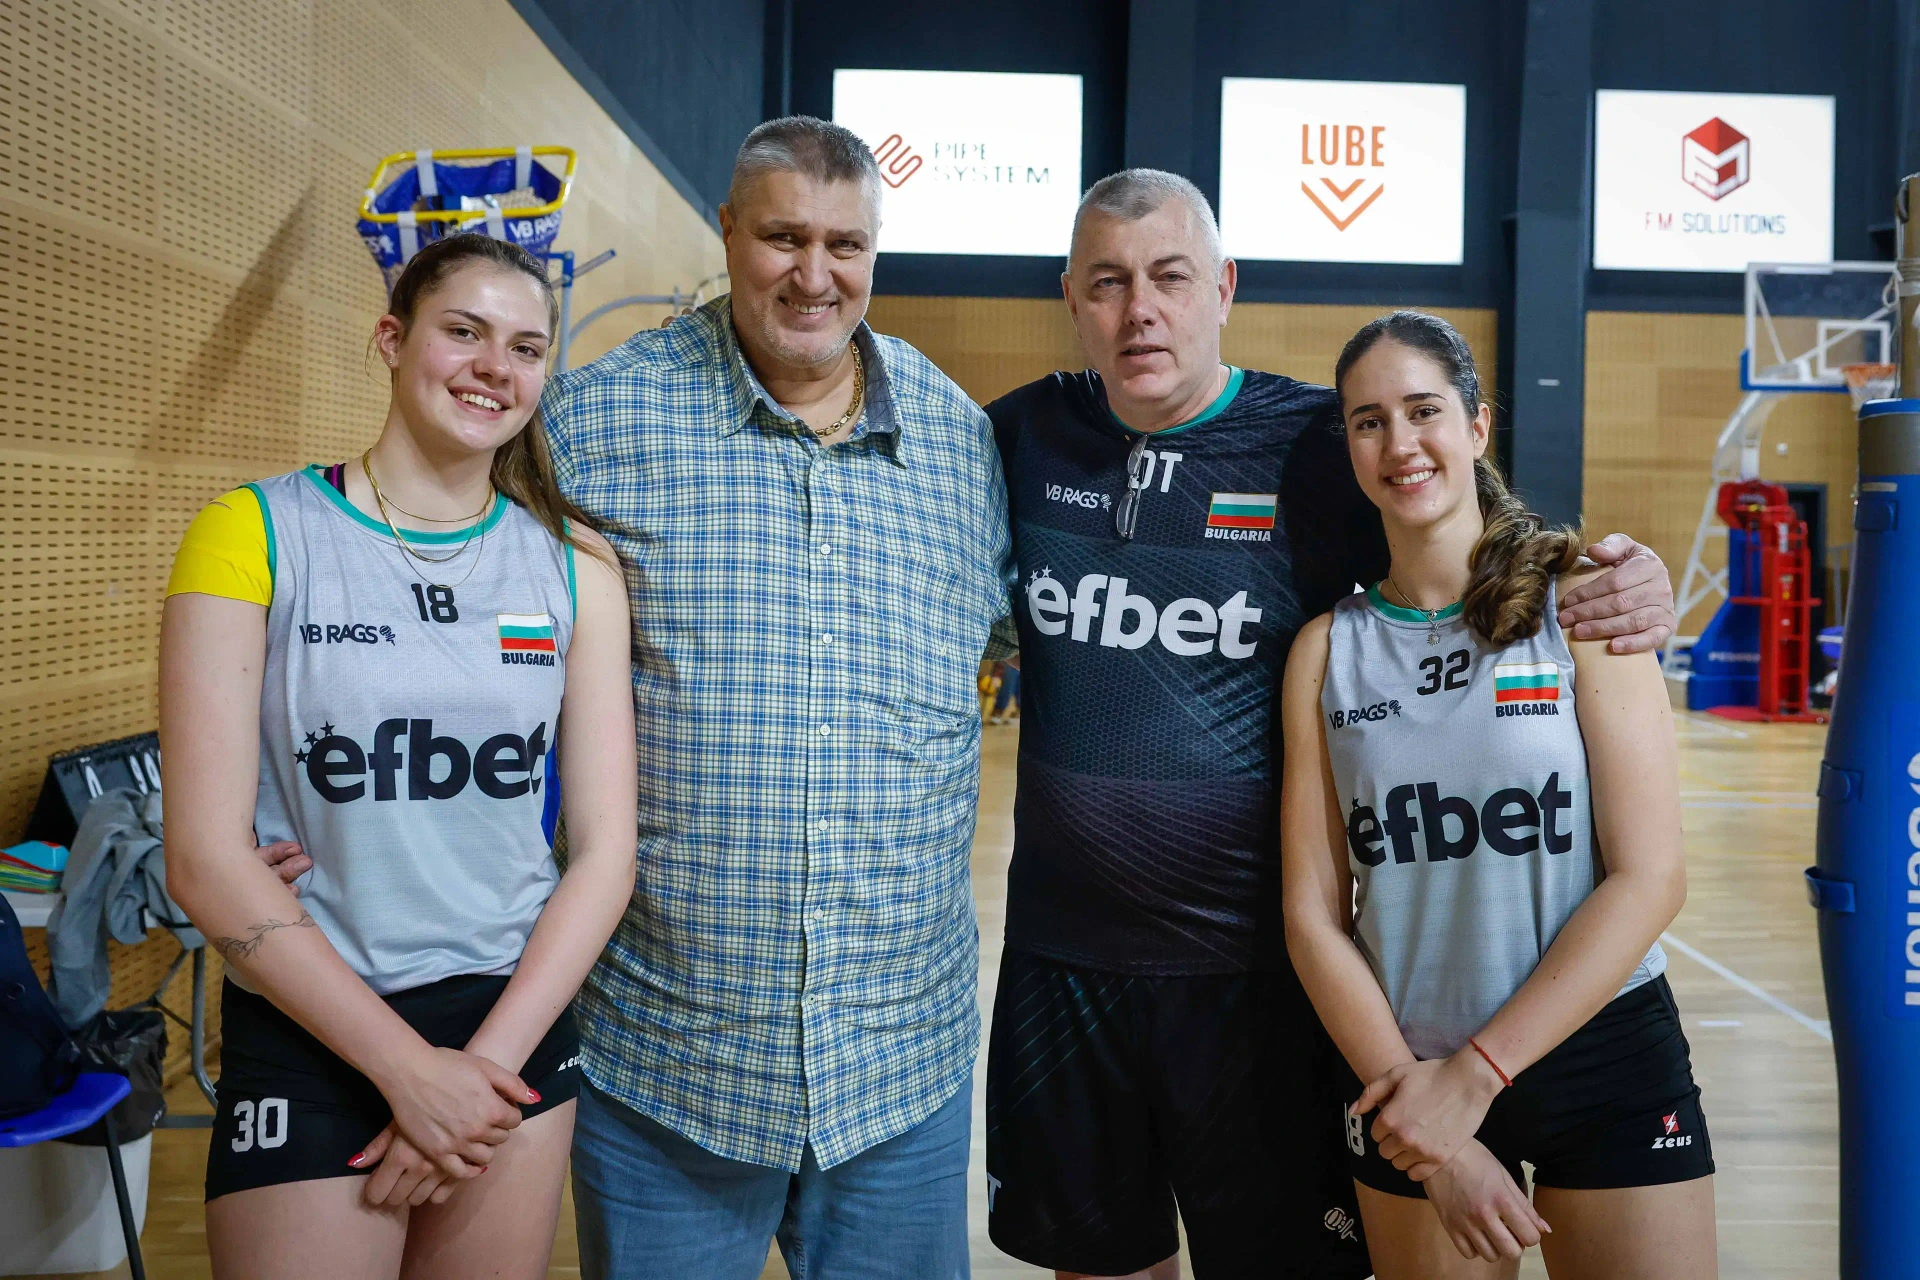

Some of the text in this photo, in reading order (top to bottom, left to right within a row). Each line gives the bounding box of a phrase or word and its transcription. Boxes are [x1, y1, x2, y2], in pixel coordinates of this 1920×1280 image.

[934, 142, 986, 160] PIPE
[1301, 123, 1386, 167] LUBE
[934, 166, 1050, 183] SYSTEM
[508, 220, 534, 239] VB
[1682, 212, 1787, 234] SOLUTIONS
[1046, 483, 1100, 509] VB RAGS
[1204, 528, 1272, 542] BULGARIA
[411, 583, 459, 623] 18
[1028, 573, 1263, 660] efbet
[299, 624, 378, 645] VB RAGS
[501, 652, 555, 667] BULGARIA
[1416, 649, 1470, 696] 32
[1329, 702, 1387, 730] VB RAGS
[1495, 703, 1559, 718] BULGARIA
[306, 718, 546, 803] efbet
[1348, 771, 1572, 868] efbet
[231, 1097, 289, 1152] 30
[1651, 1135, 1692, 1149] Zeus
